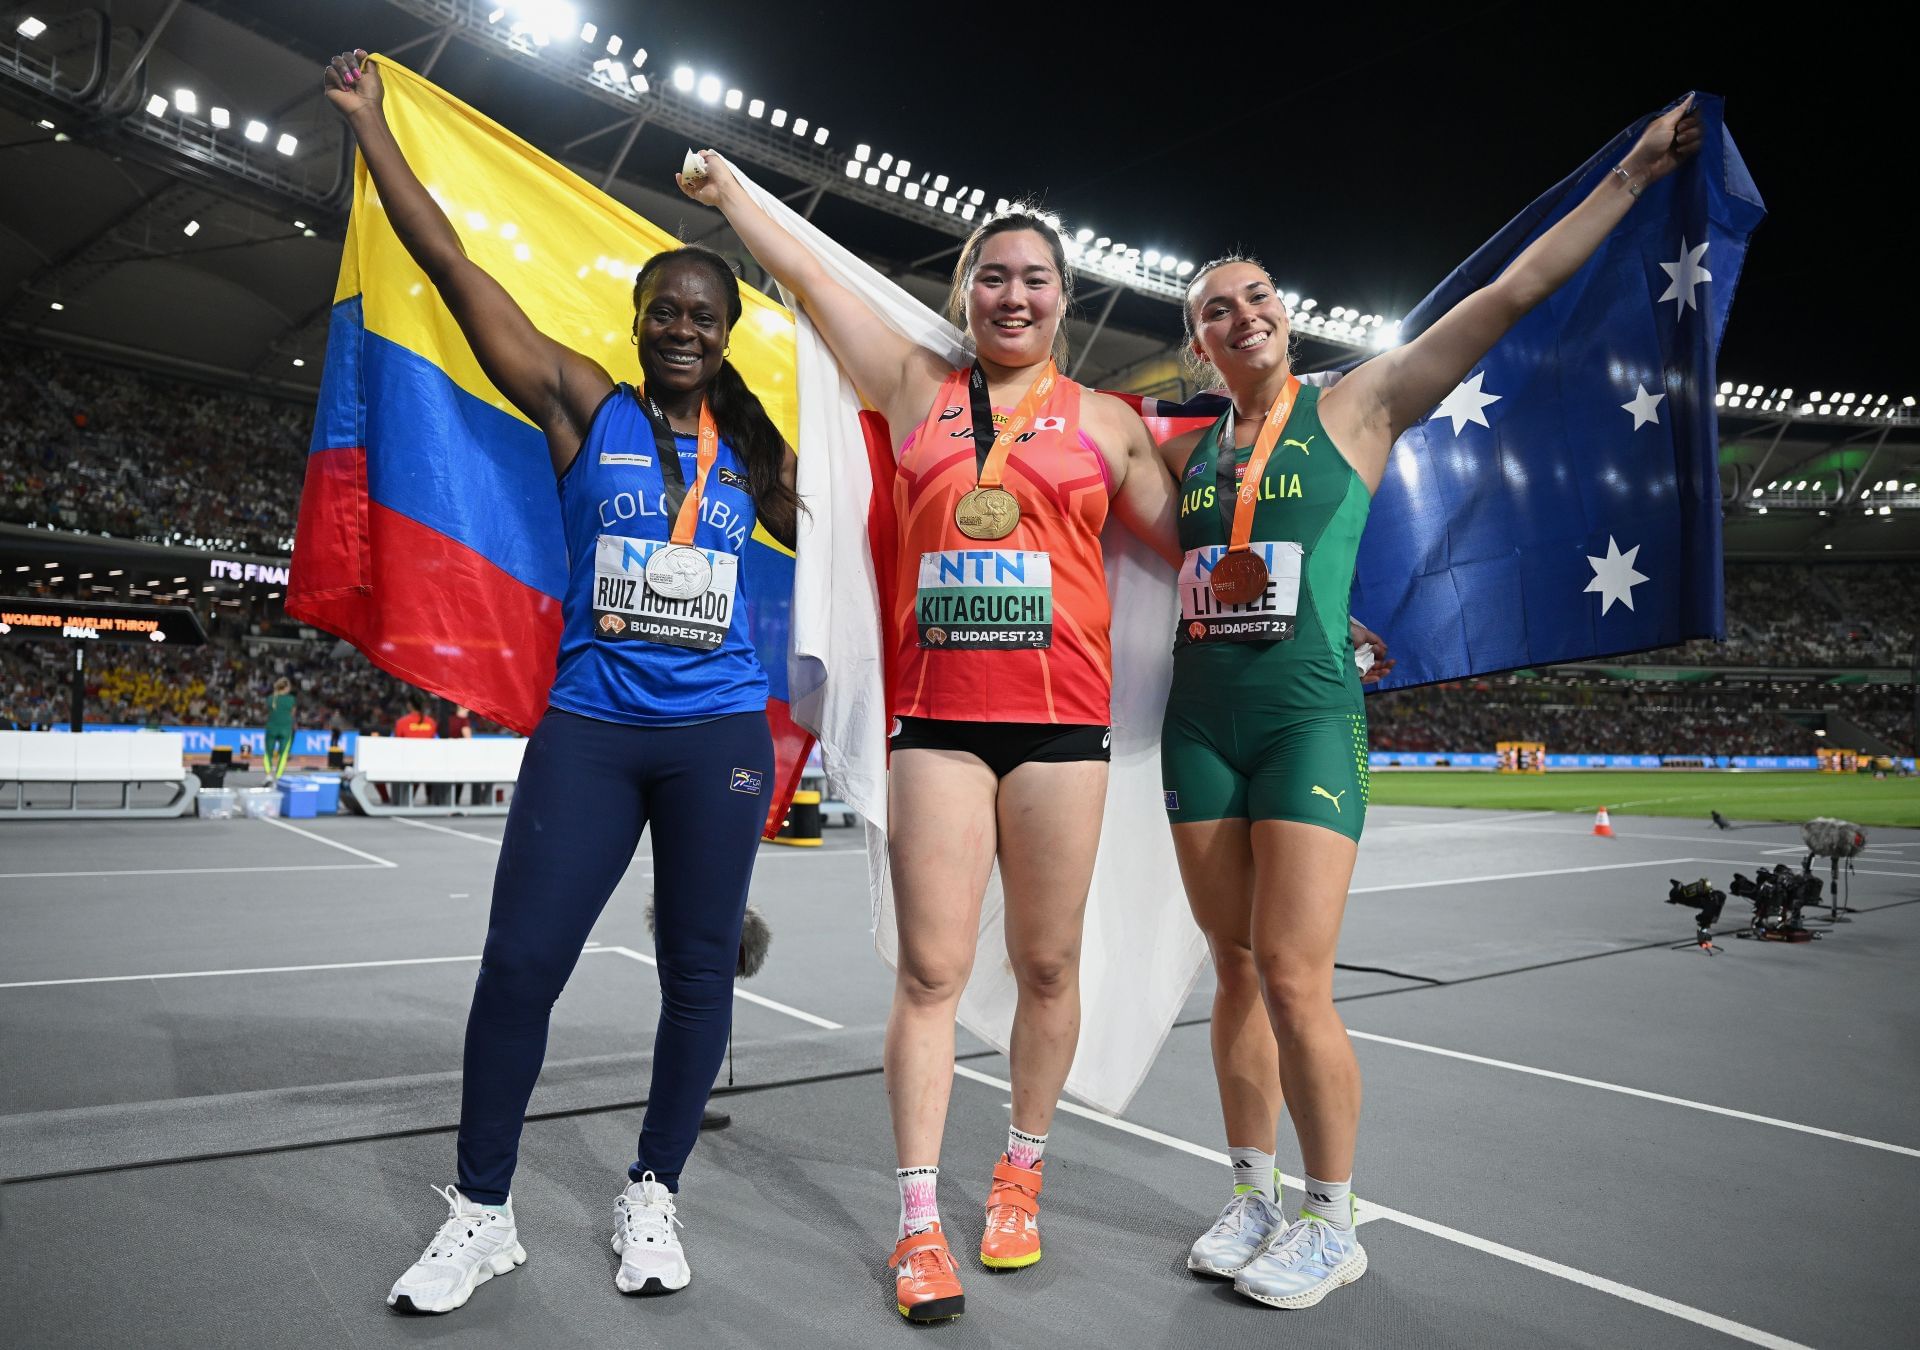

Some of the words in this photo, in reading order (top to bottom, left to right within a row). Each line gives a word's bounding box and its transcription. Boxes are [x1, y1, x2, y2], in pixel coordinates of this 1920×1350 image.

[950, 427, 1037, 443] JAN
[1181, 473, 1303, 518] AUSLIA
[210, 559, 243, 581] IT'S
[939, 551, 1025, 585] NTN
[597, 576, 638, 610] RUIZ
[921, 595, 1044, 622] KITAGUCHI
[1, 612, 62, 628] WOMEN'S
[63, 616, 114, 630] JAVELIN
[114, 618, 159, 632] THROW
[62, 625, 100, 639] FINAL
[630, 621, 707, 642] BUDAPEST
[708, 632, 723, 643] 23
[1209, 621, 1270, 635] BUDAPEST
[1271, 621, 1287, 633] 23
[950, 631, 1026, 642] BUDAPEST
[1027, 630, 1044, 642] 23
[183, 731, 216, 750] TN
[240, 733, 266, 753] NT
